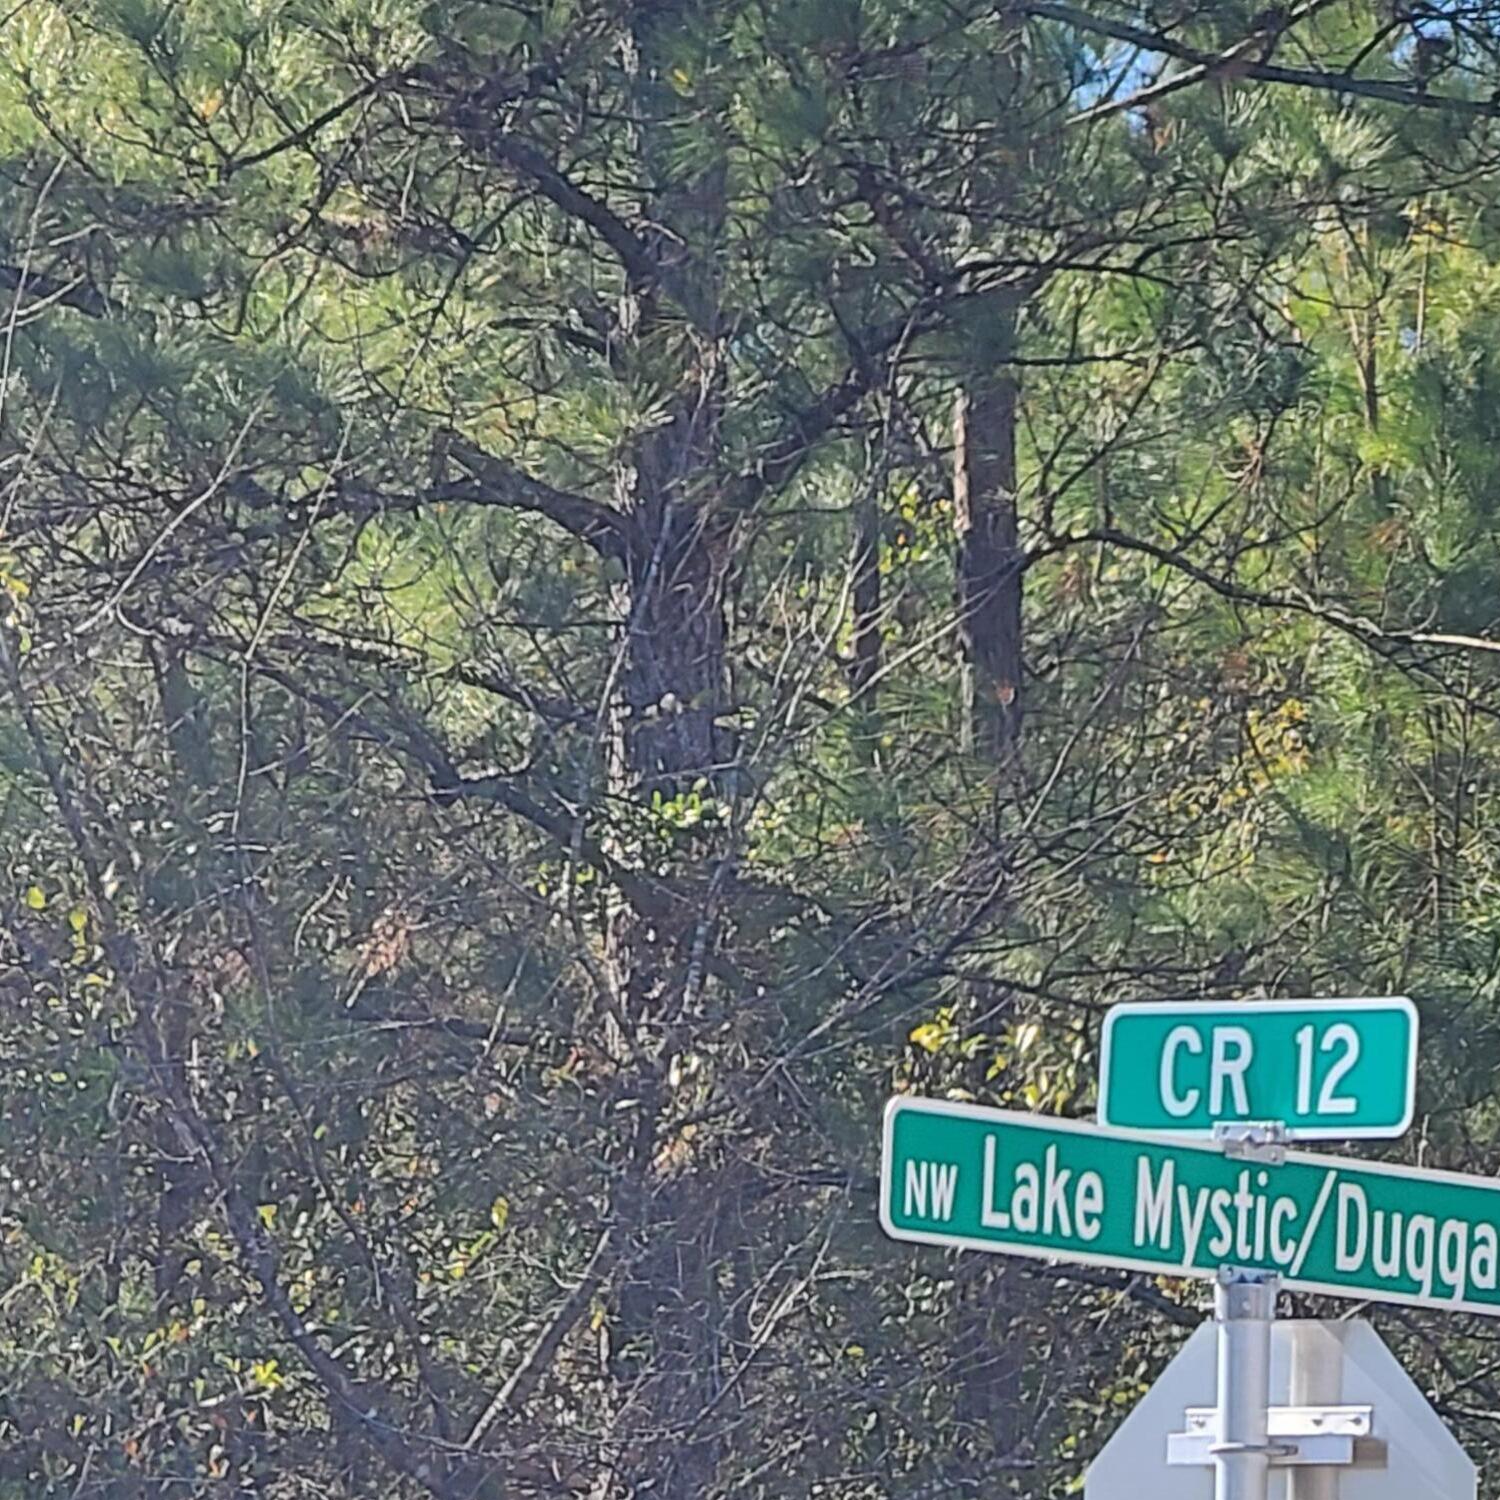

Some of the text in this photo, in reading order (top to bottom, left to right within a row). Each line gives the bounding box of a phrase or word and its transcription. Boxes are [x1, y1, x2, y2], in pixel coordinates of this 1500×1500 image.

[1161, 1023, 1361, 1116] CR 12
[904, 1159, 957, 1221] NW
[981, 1134, 1102, 1240] Lake
